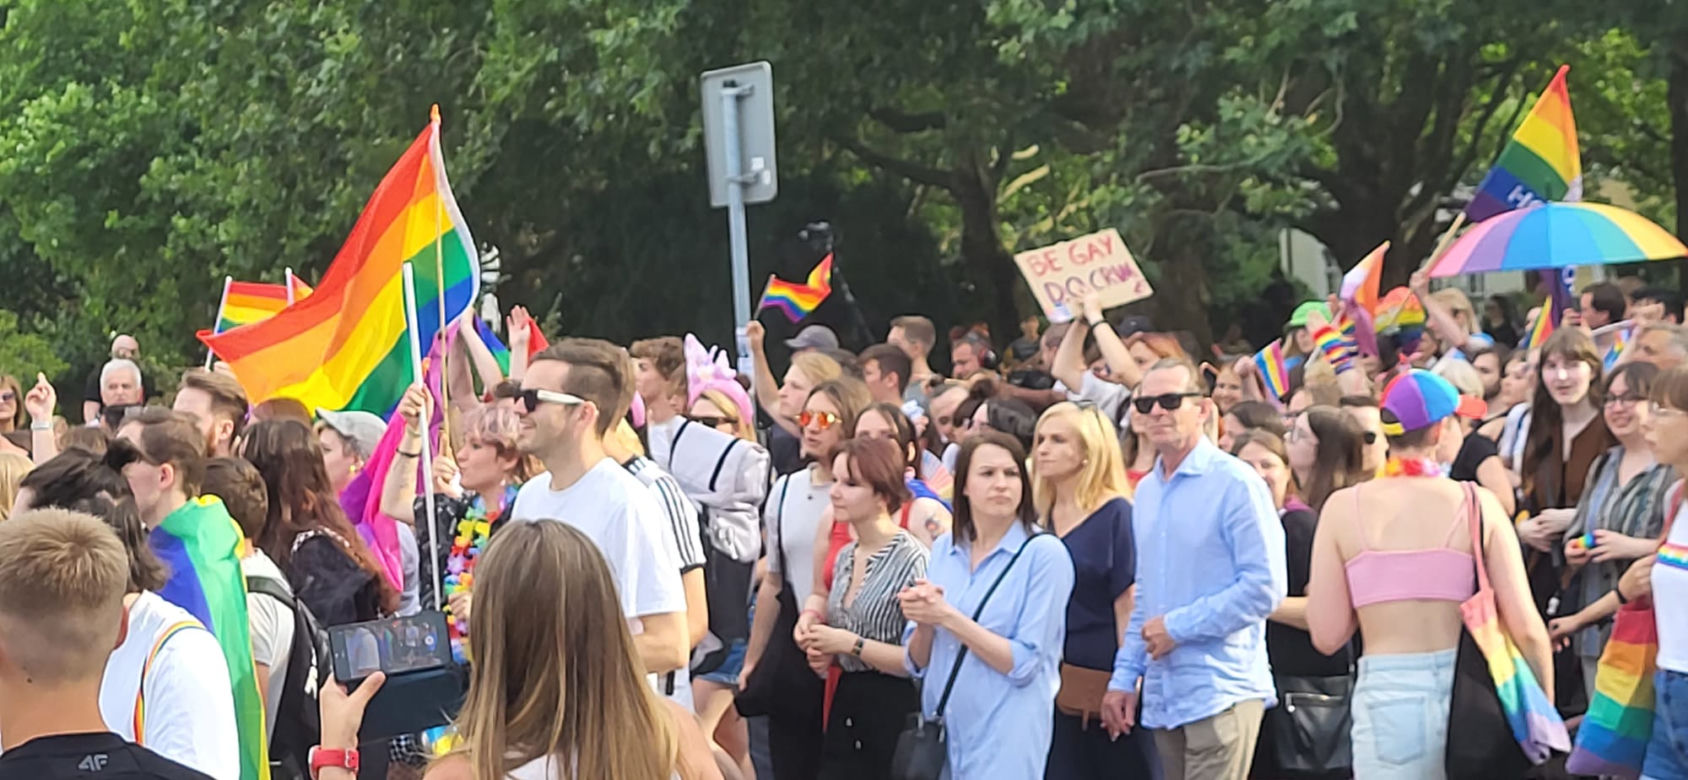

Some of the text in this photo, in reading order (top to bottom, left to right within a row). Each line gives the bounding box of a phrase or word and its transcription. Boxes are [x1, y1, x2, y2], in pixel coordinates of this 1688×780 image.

[1026, 235, 1113, 276] BE GAY
[78, 754, 108, 771] 4F
